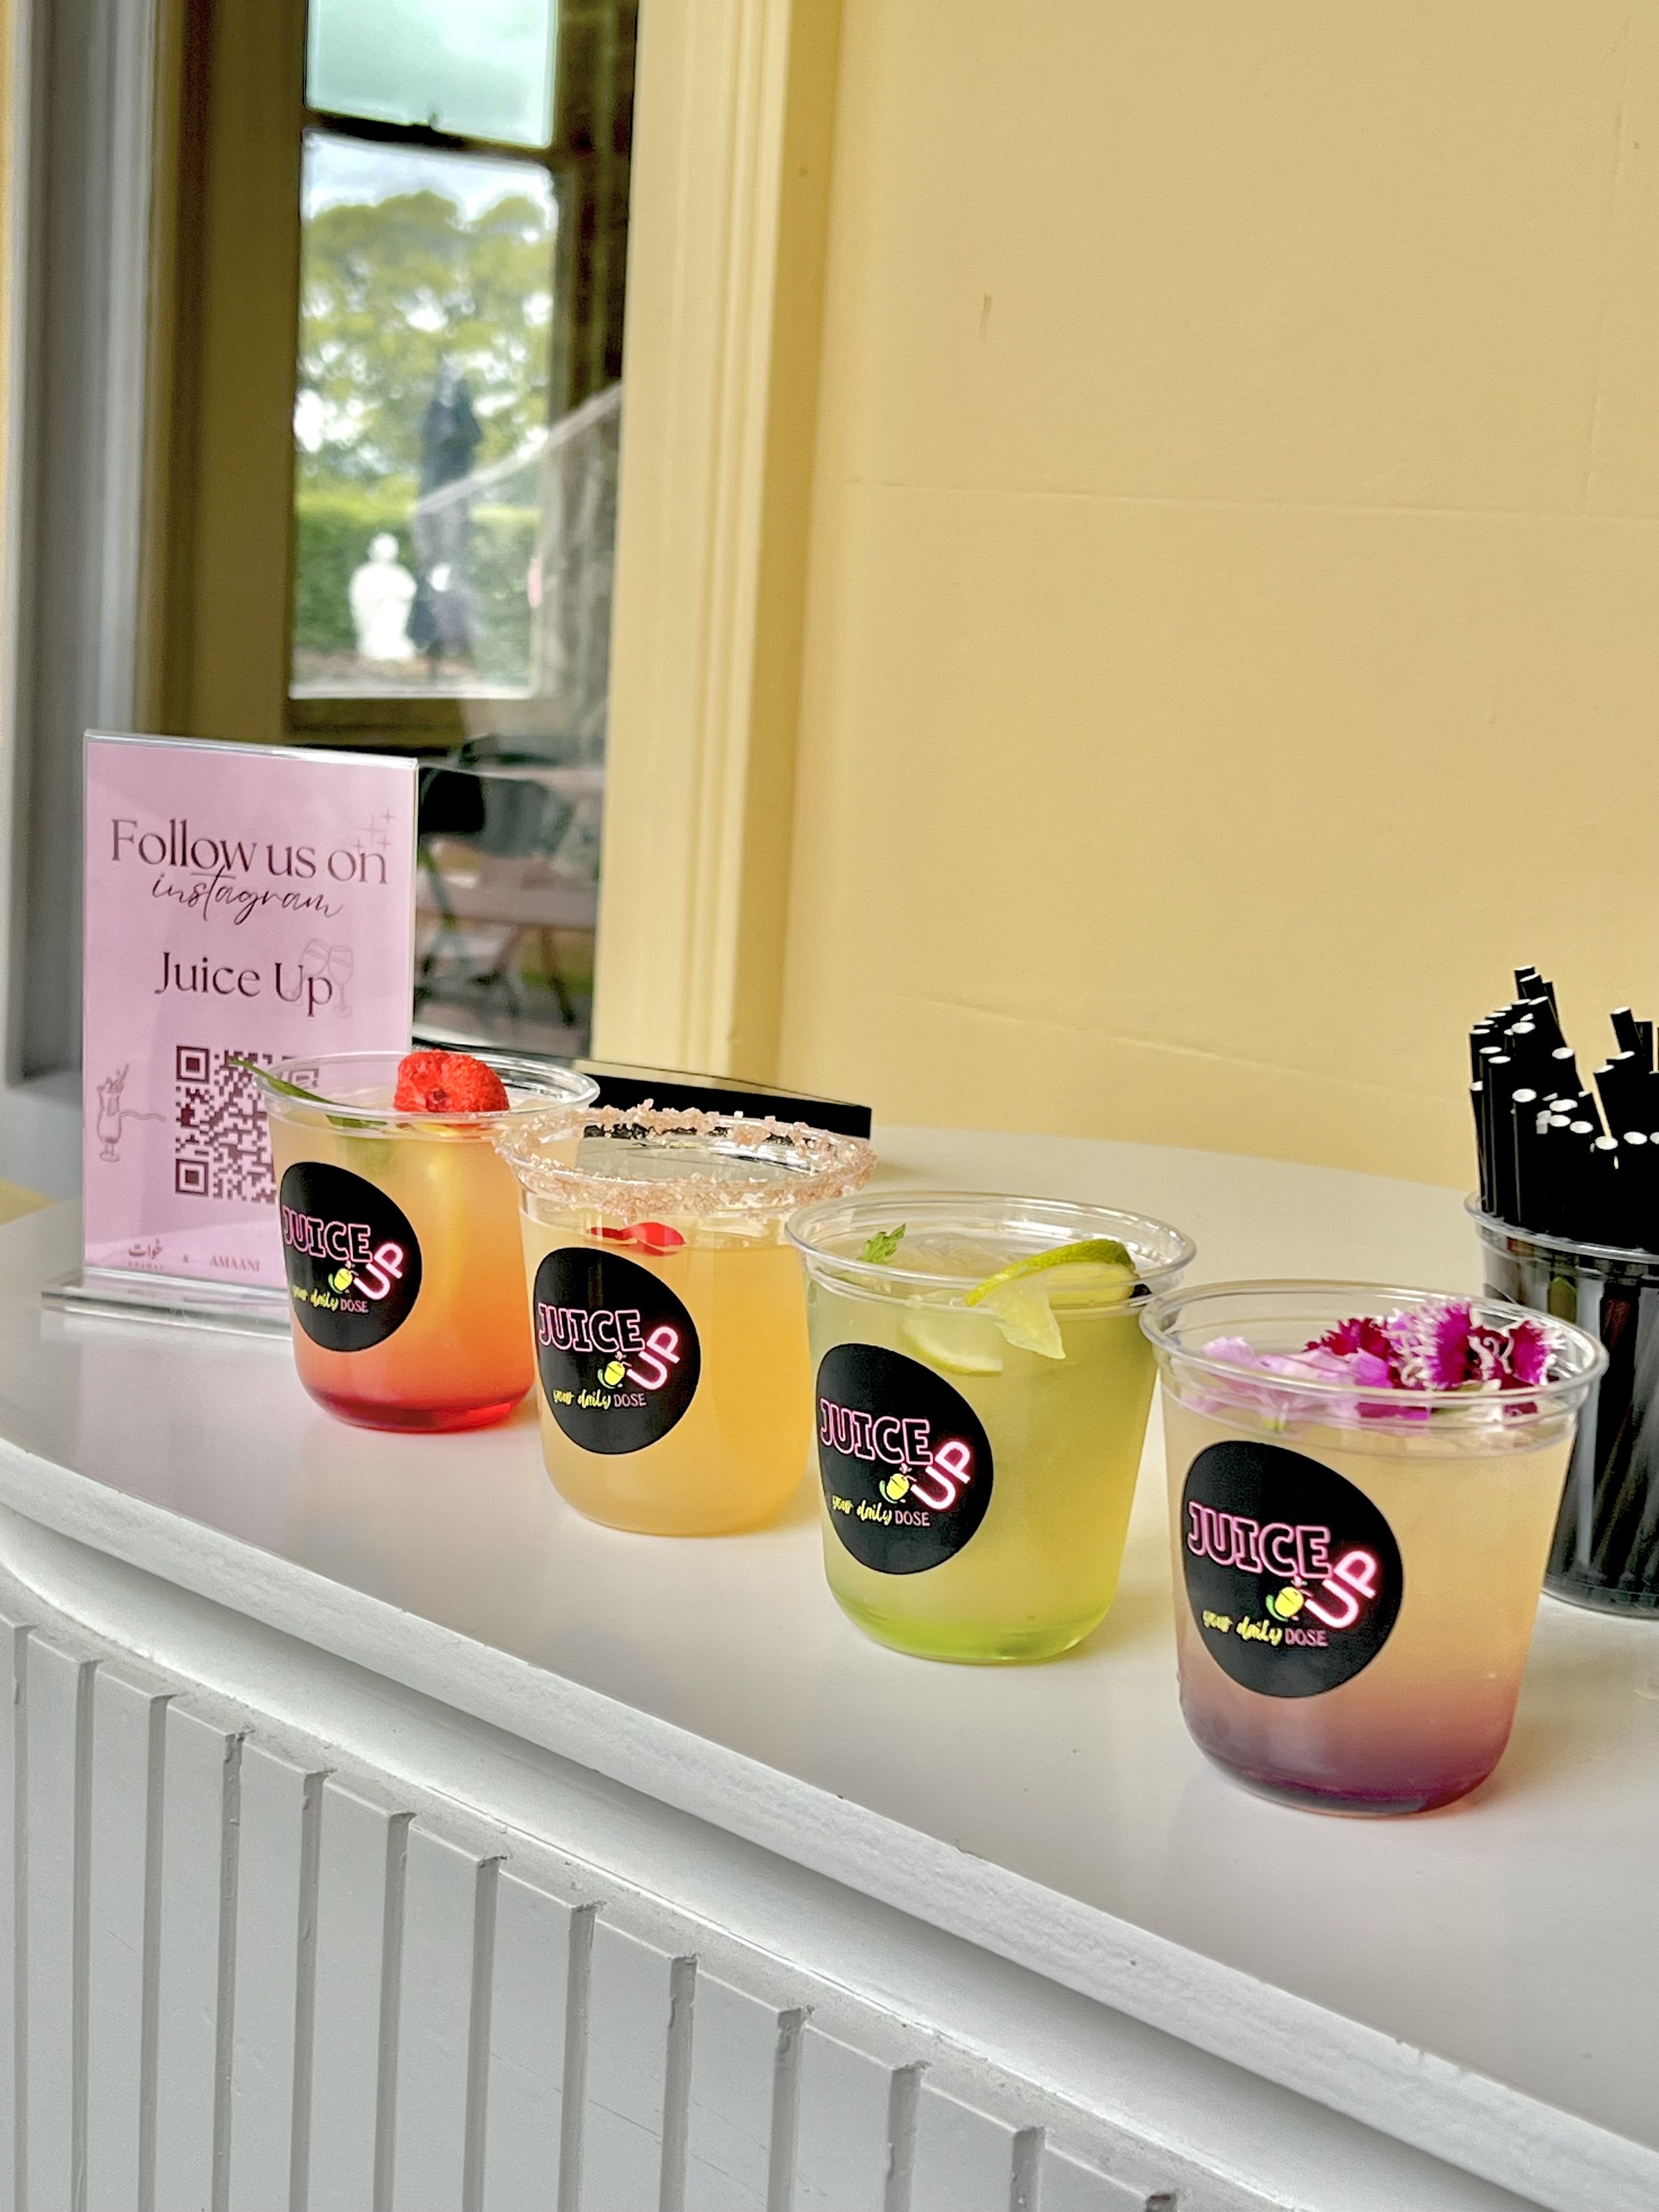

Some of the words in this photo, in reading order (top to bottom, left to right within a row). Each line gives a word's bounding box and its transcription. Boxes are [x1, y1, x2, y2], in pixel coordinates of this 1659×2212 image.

[111, 818, 257, 872] Follow
[268, 844, 317, 879] us
[328, 848, 388, 885] on
[151, 865, 344, 925] instagram
[155, 951, 261, 996] Juice
[275, 962, 333, 1017] Up
[281, 1205, 373, 1263] JUICE
[353, 1242, 403, 1300] UP
[340, 1298, 369, 1313] DOSE
[538, 1302, 646, 1353] JUICE
[626, 1325, 680, 1390] UP
[614, 1392, 647, 1408] DOSE
[820, 1398, 933, 1465] JUICE
[910, 1441, 971, 1510] UP
[857, 1499, 893, 1526] daily
[895, 1510, 931, 1527] DOSE
[1187, 1501, 1333, 1579] JUICE
[1304, 1550, 1378, 1629] UP
[1285, 1628, 1328, 1647] DOSE
